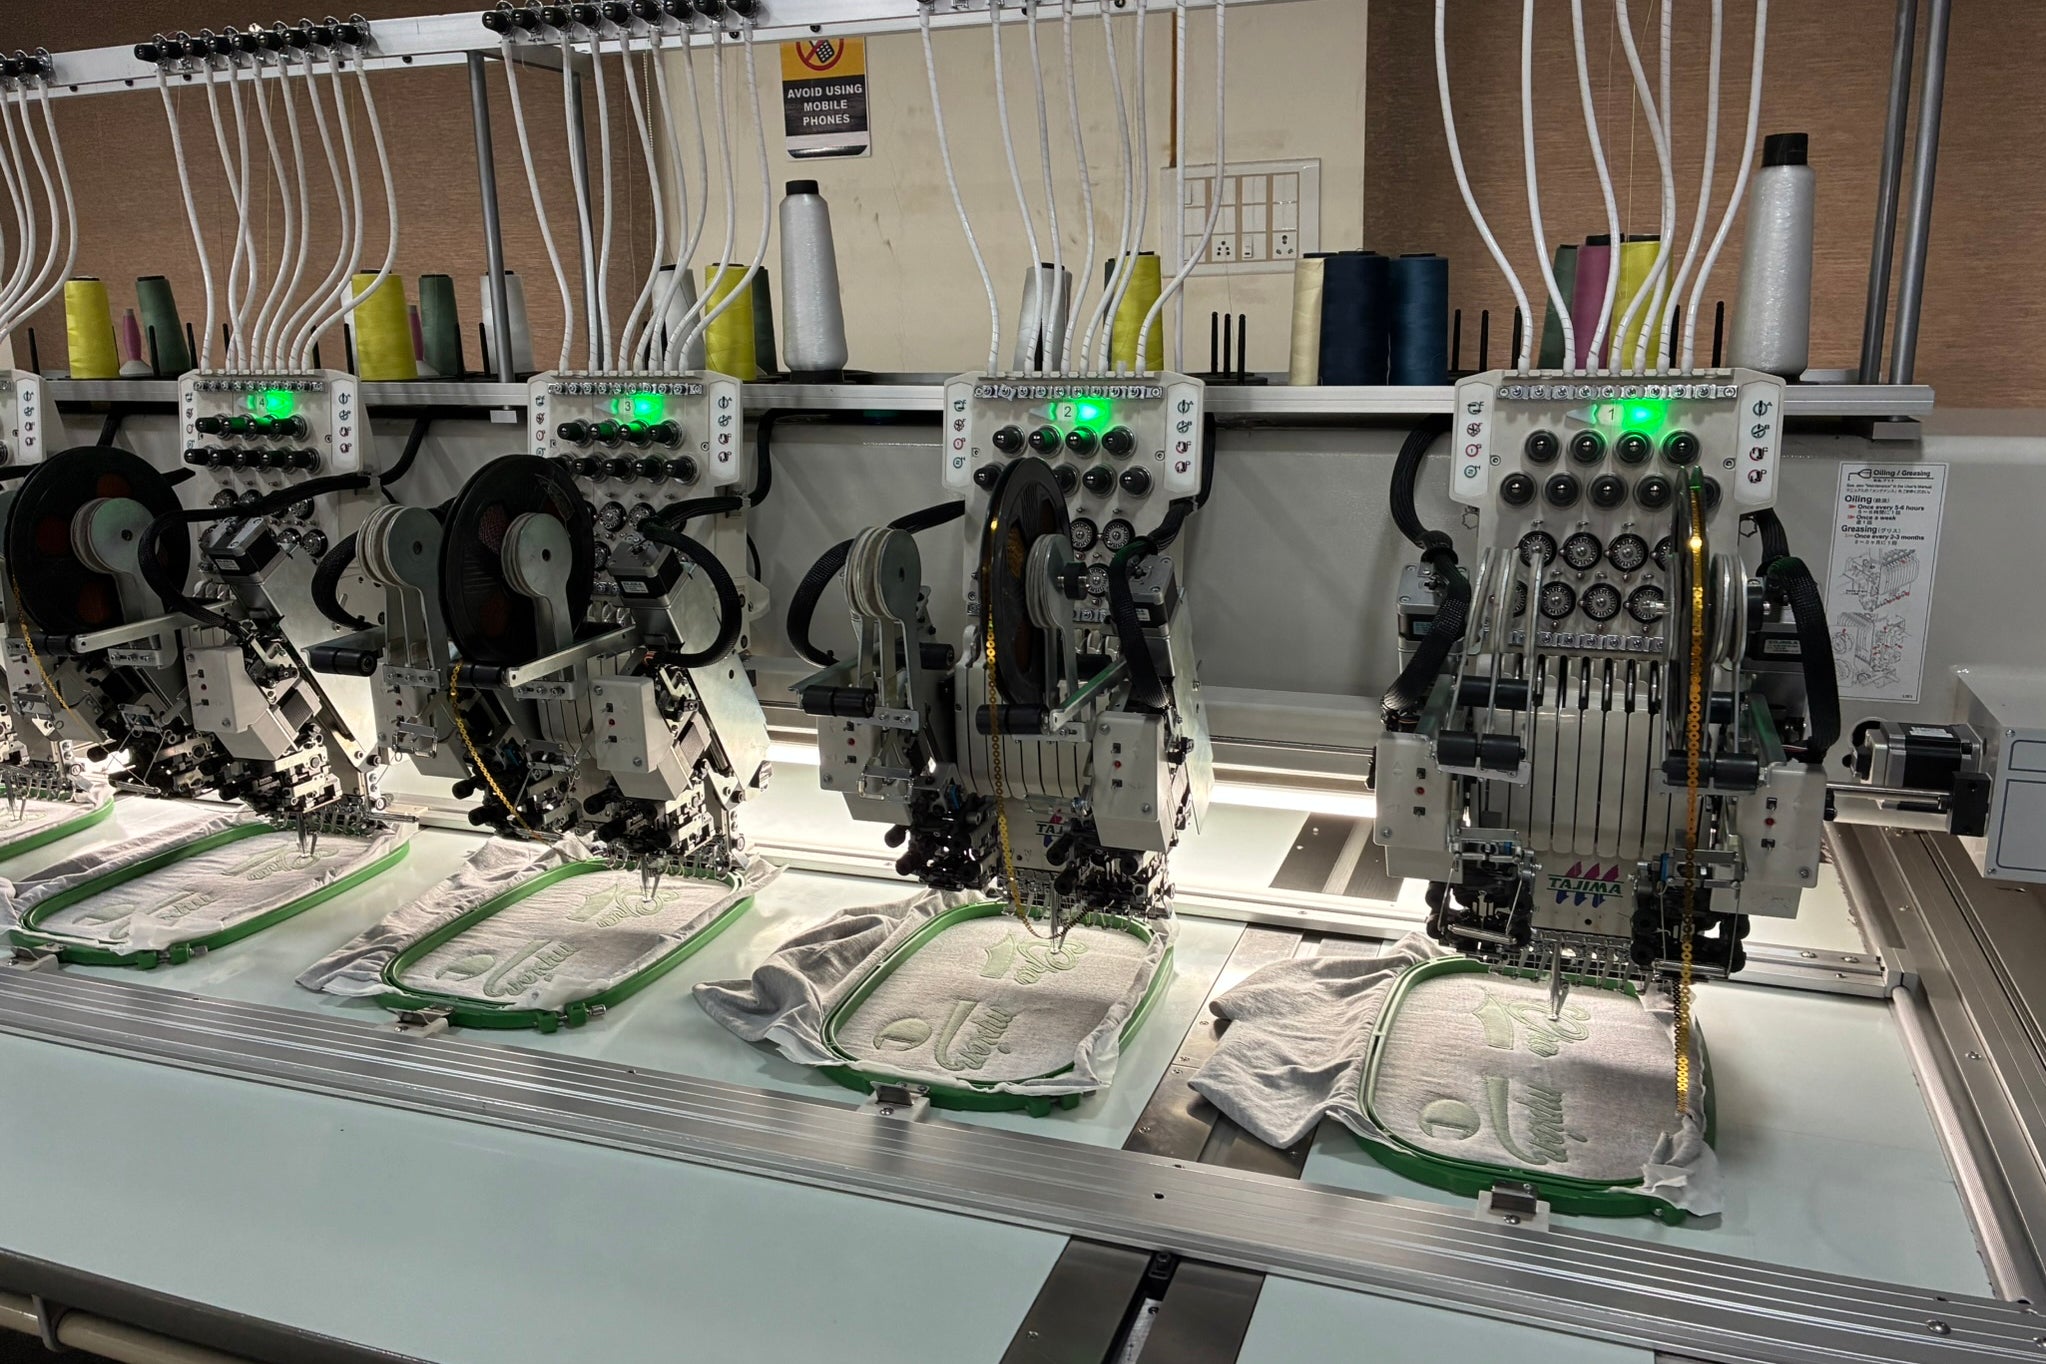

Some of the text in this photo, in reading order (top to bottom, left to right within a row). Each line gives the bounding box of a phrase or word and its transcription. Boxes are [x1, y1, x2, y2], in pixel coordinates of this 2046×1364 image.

[787, 84, 862, 98] AVOID USING
[804, 100, 848, 111] MOBILE
[803, 114, 850, 126] PHONES
[624, 402, 631, 412] 3
[1063, 406, 1072, 417] 2
[1608, 408, 1615, 420] 1
[1901, 470, 1931, 478] Greasing
[1845, 495, 1872, 504] Oiling
[1841, 524, 1877, 534] Greasing
[1036, 823, 1064, 834] TAJ
[1548, 877, 1622, 895] TAJIMA
